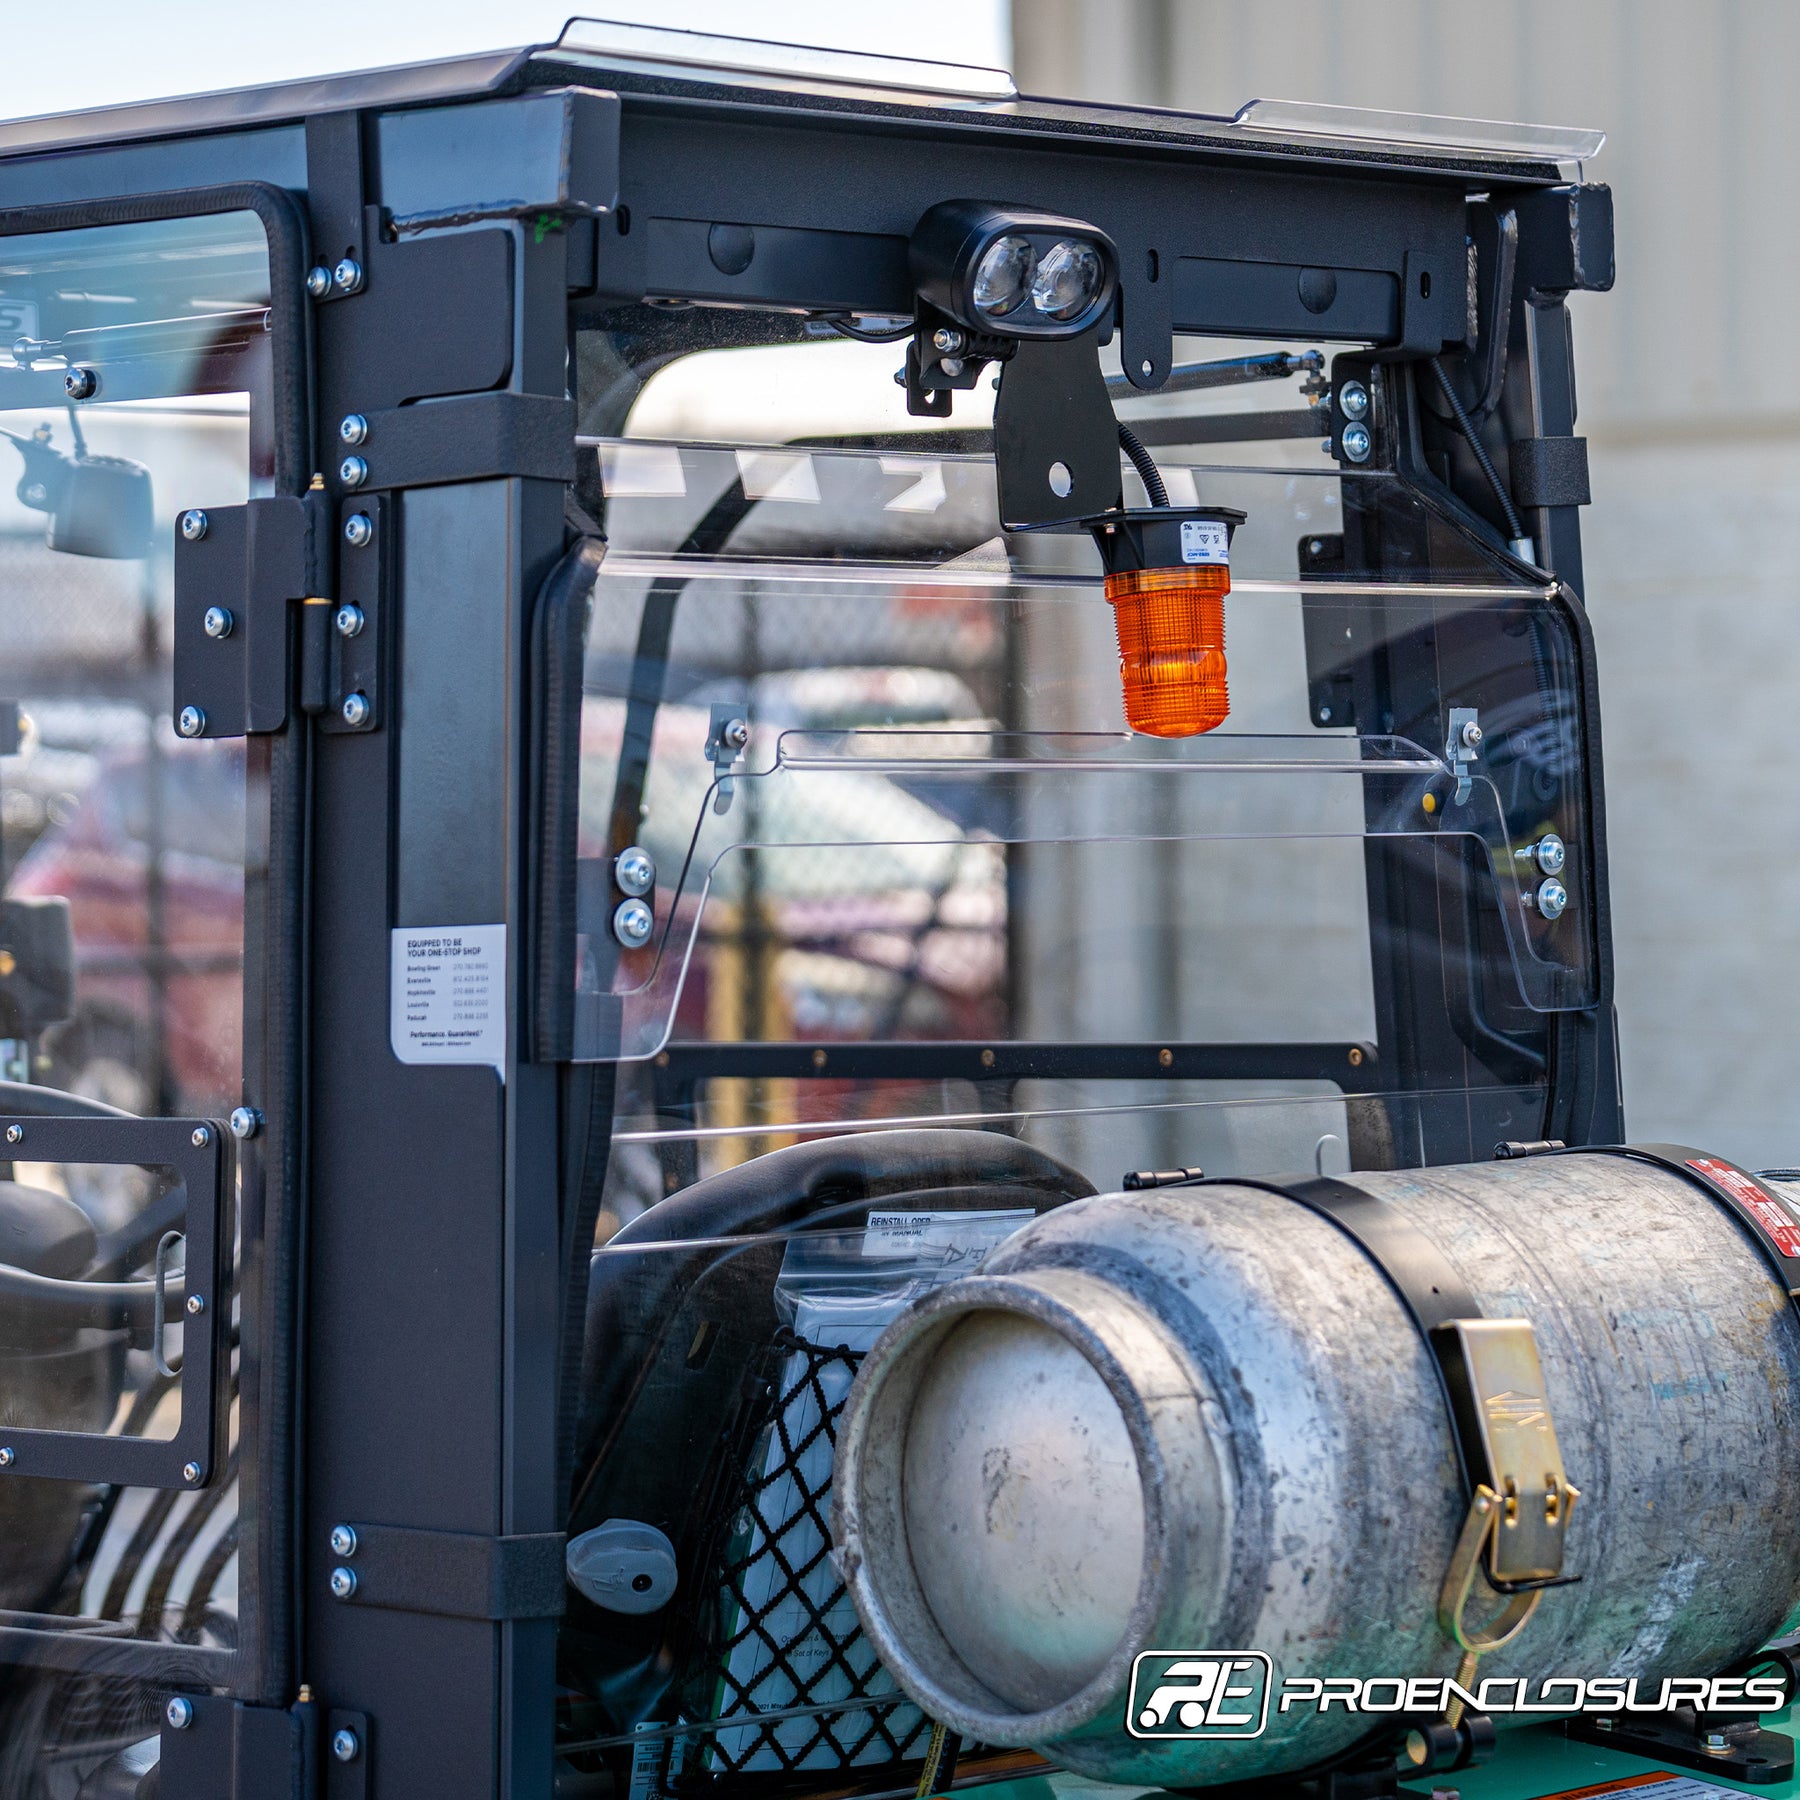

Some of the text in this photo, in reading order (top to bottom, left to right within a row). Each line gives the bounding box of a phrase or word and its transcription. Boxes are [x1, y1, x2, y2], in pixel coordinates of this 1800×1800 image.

[407, 937, 462, 948] EQUIPPED TO BE
[407, 946, 482, 958] YOUR ONE-STOP SHOP
[407, 964, 426, 973] Bowling
[407, 976, 431, 984] Evansville
